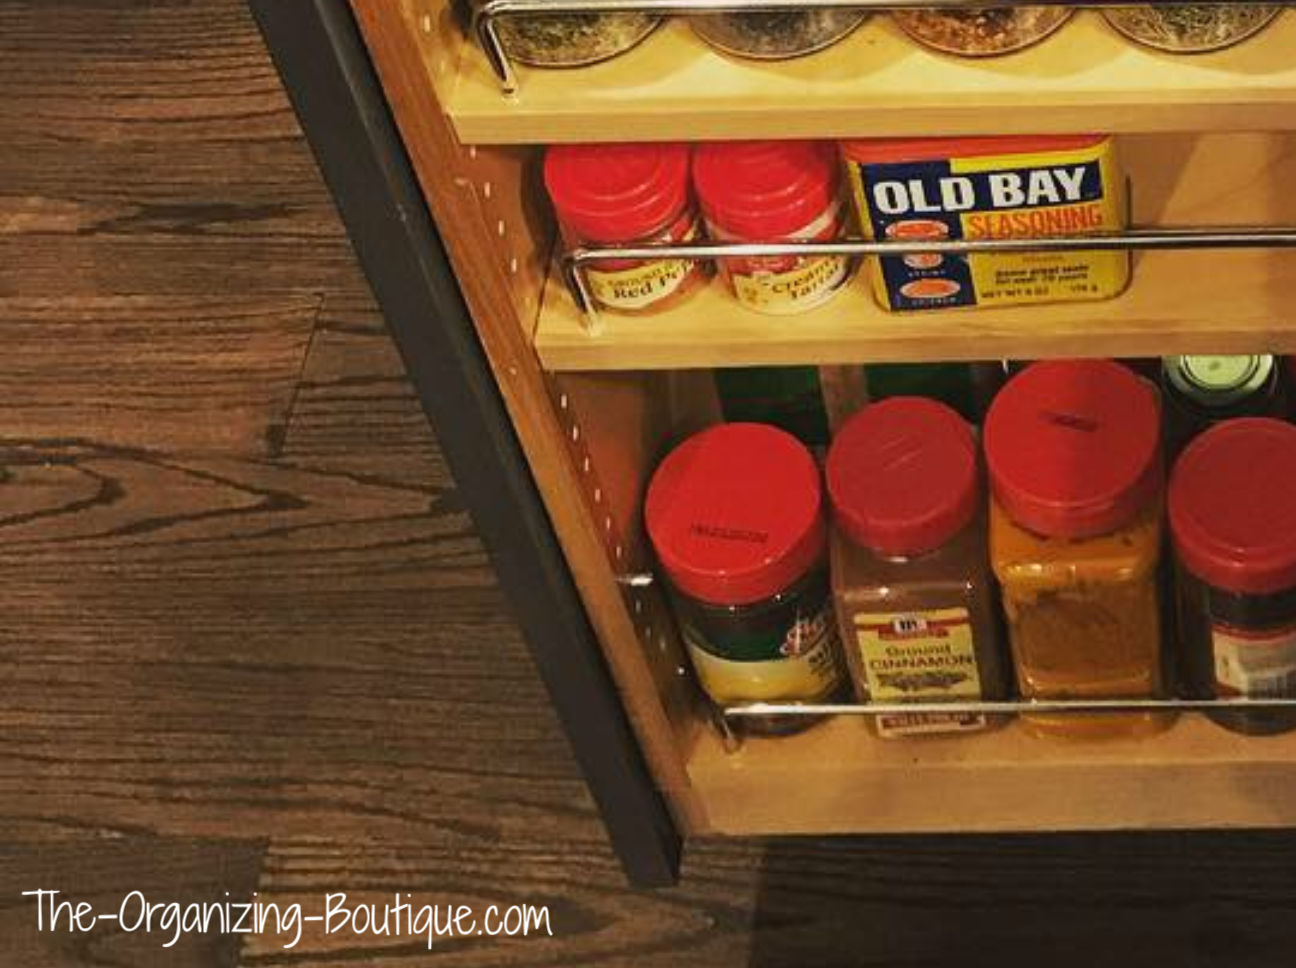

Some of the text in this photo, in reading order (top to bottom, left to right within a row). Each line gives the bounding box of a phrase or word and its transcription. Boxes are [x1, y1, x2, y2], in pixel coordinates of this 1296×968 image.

[873, 166, 1087, 215] OLD BAY
[969, 203, 1103, 240] SEASONING
[869, 654, 975, 671] CINNAMON
[885, 643, 952, 656] Ground
